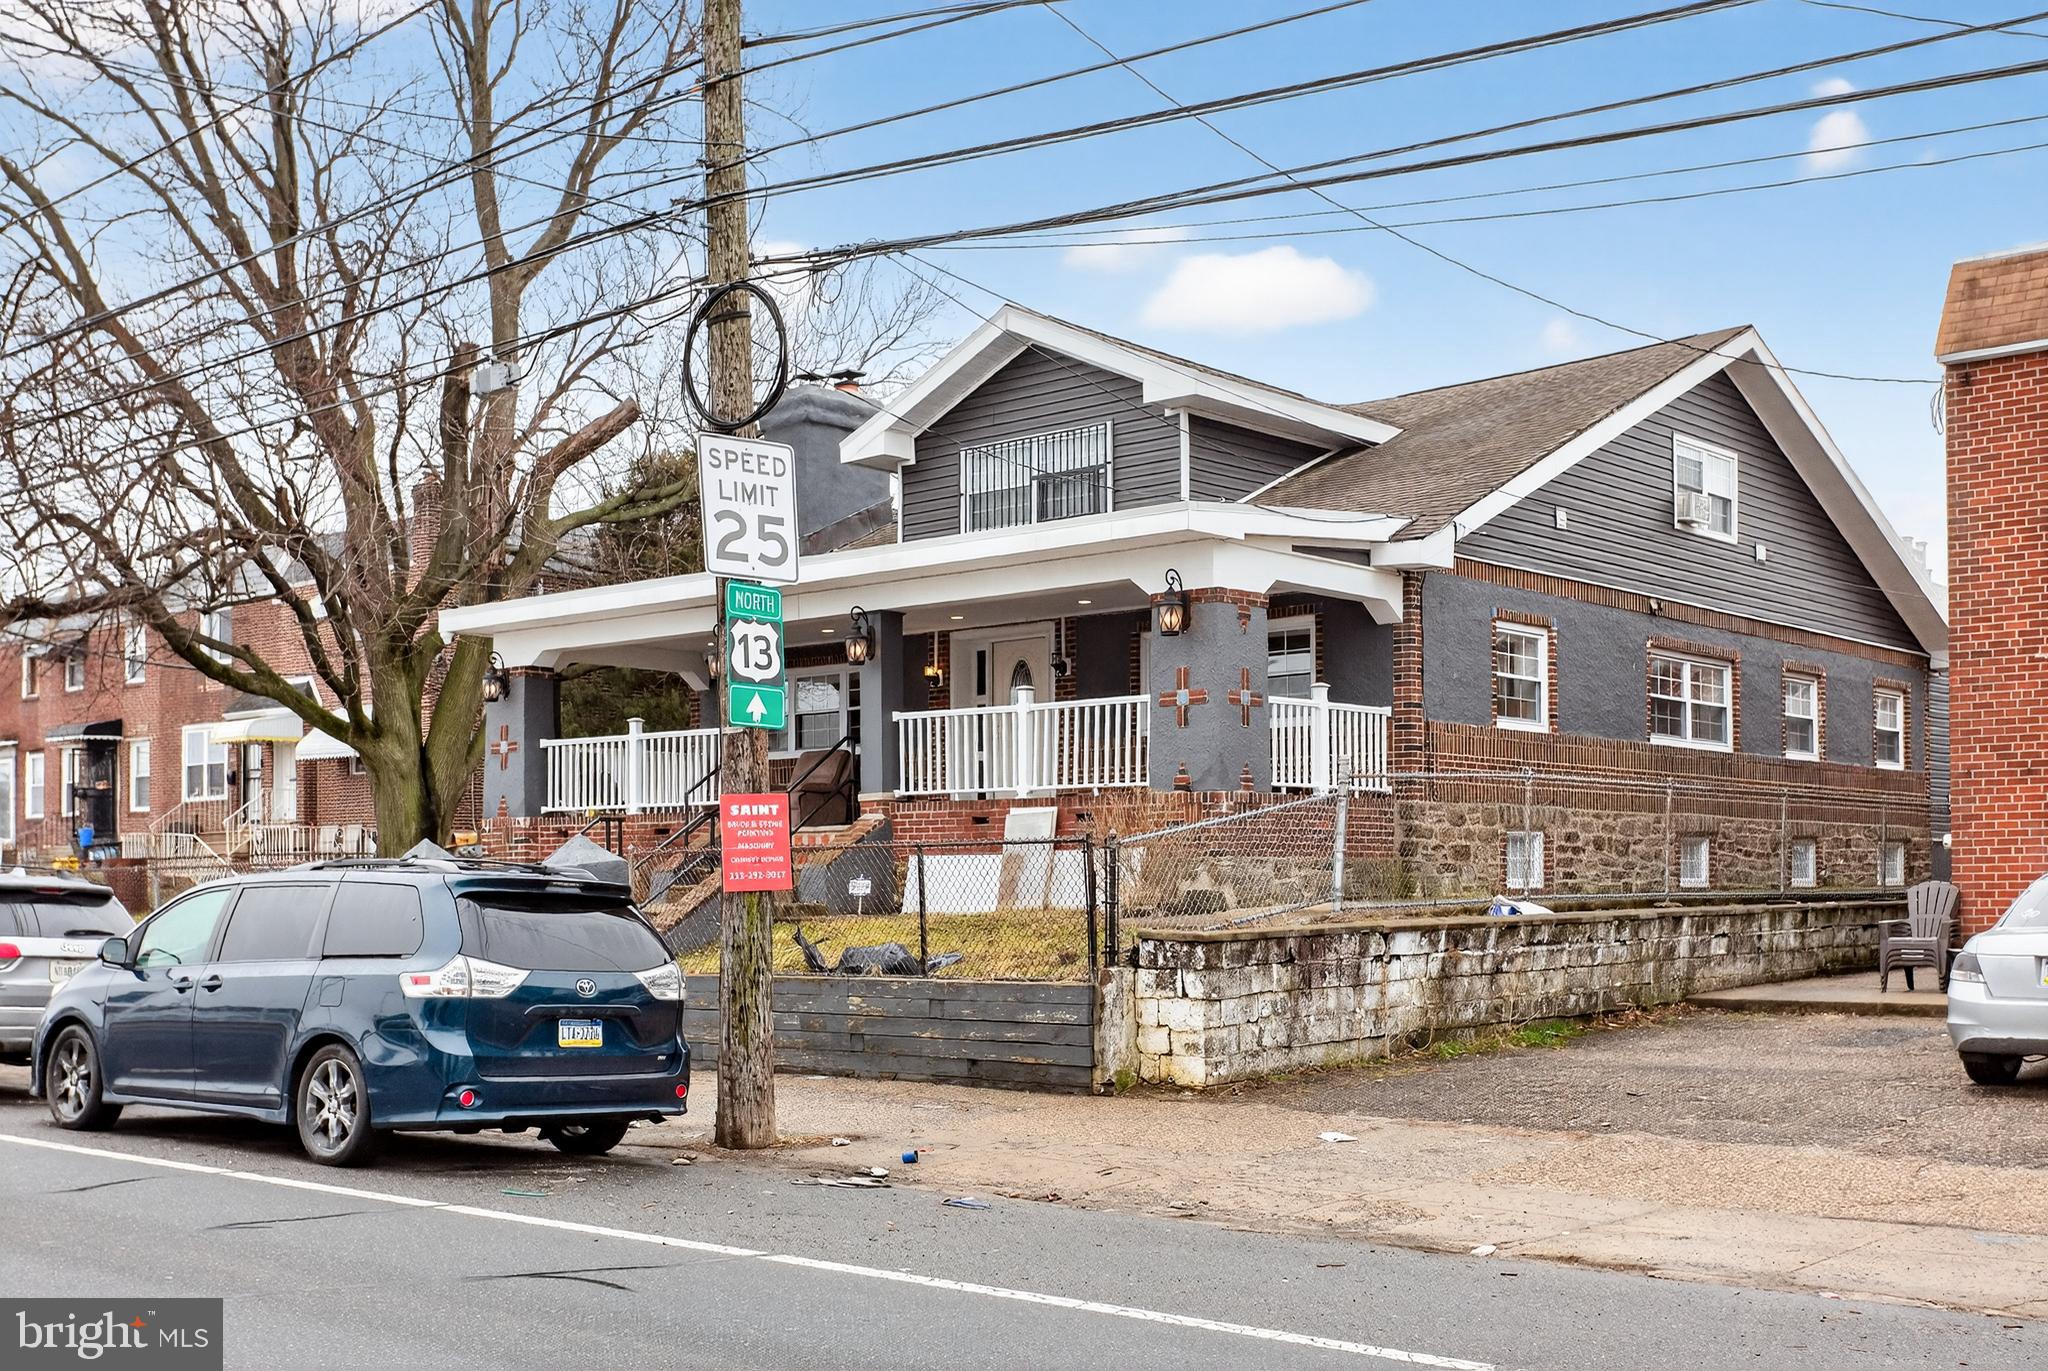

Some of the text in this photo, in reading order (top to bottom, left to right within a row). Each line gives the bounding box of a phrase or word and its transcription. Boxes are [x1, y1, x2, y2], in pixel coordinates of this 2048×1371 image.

[708, 447, 786, 478] SPEED
[718, 479, 779, 507] LIMIT
[713, 509, 789, 567] 25
[735, 590, 775, 613] NORTH
[738, 633, 773, 670] 13
[730, 804, 779, 816] SAINT
